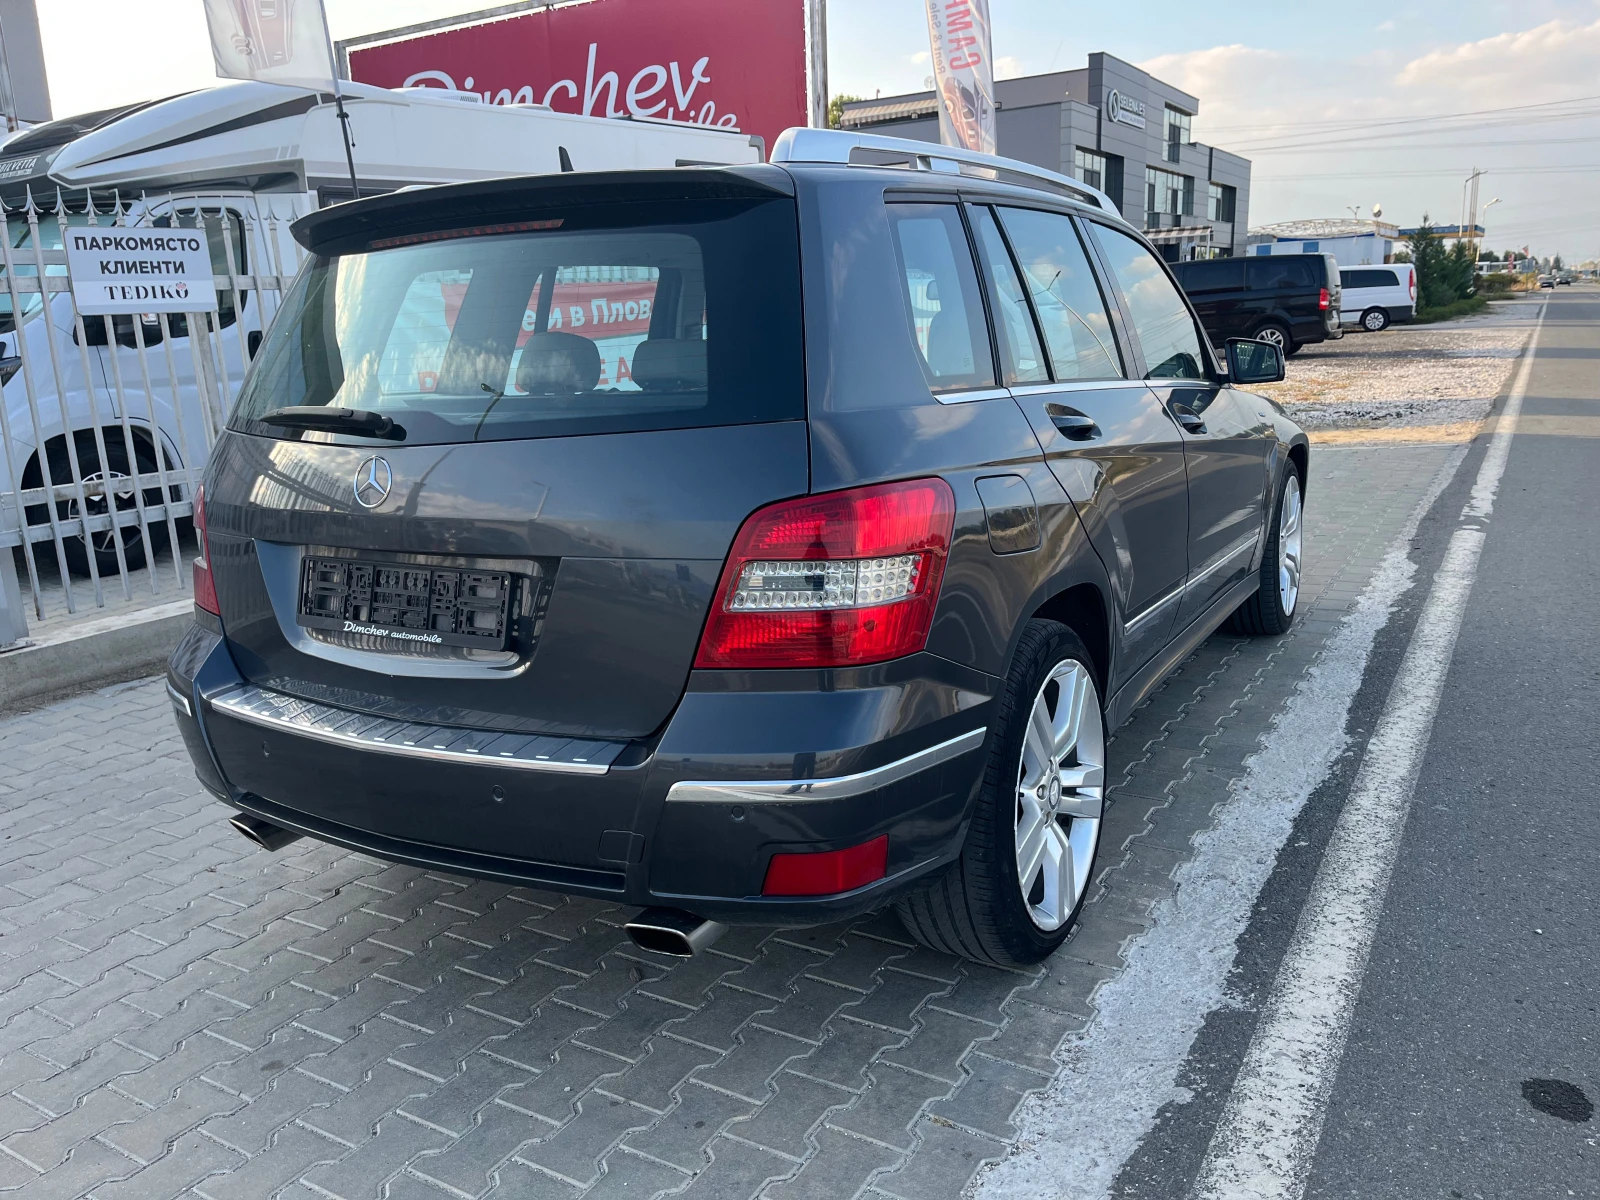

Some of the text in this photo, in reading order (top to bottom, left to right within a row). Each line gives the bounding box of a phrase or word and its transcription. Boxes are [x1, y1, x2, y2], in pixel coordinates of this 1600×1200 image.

[74, 236, 200, 251] ПАРКОМЯСТО
[100, 260, 186, 275] КЛИЕНТИ
[104, 282, 189, 300] TEDIKO
[569, 306, 585, 327] в
[591, 298, 652, 325] Плов
[343, 621, 442, 643] Dimchev automobile
